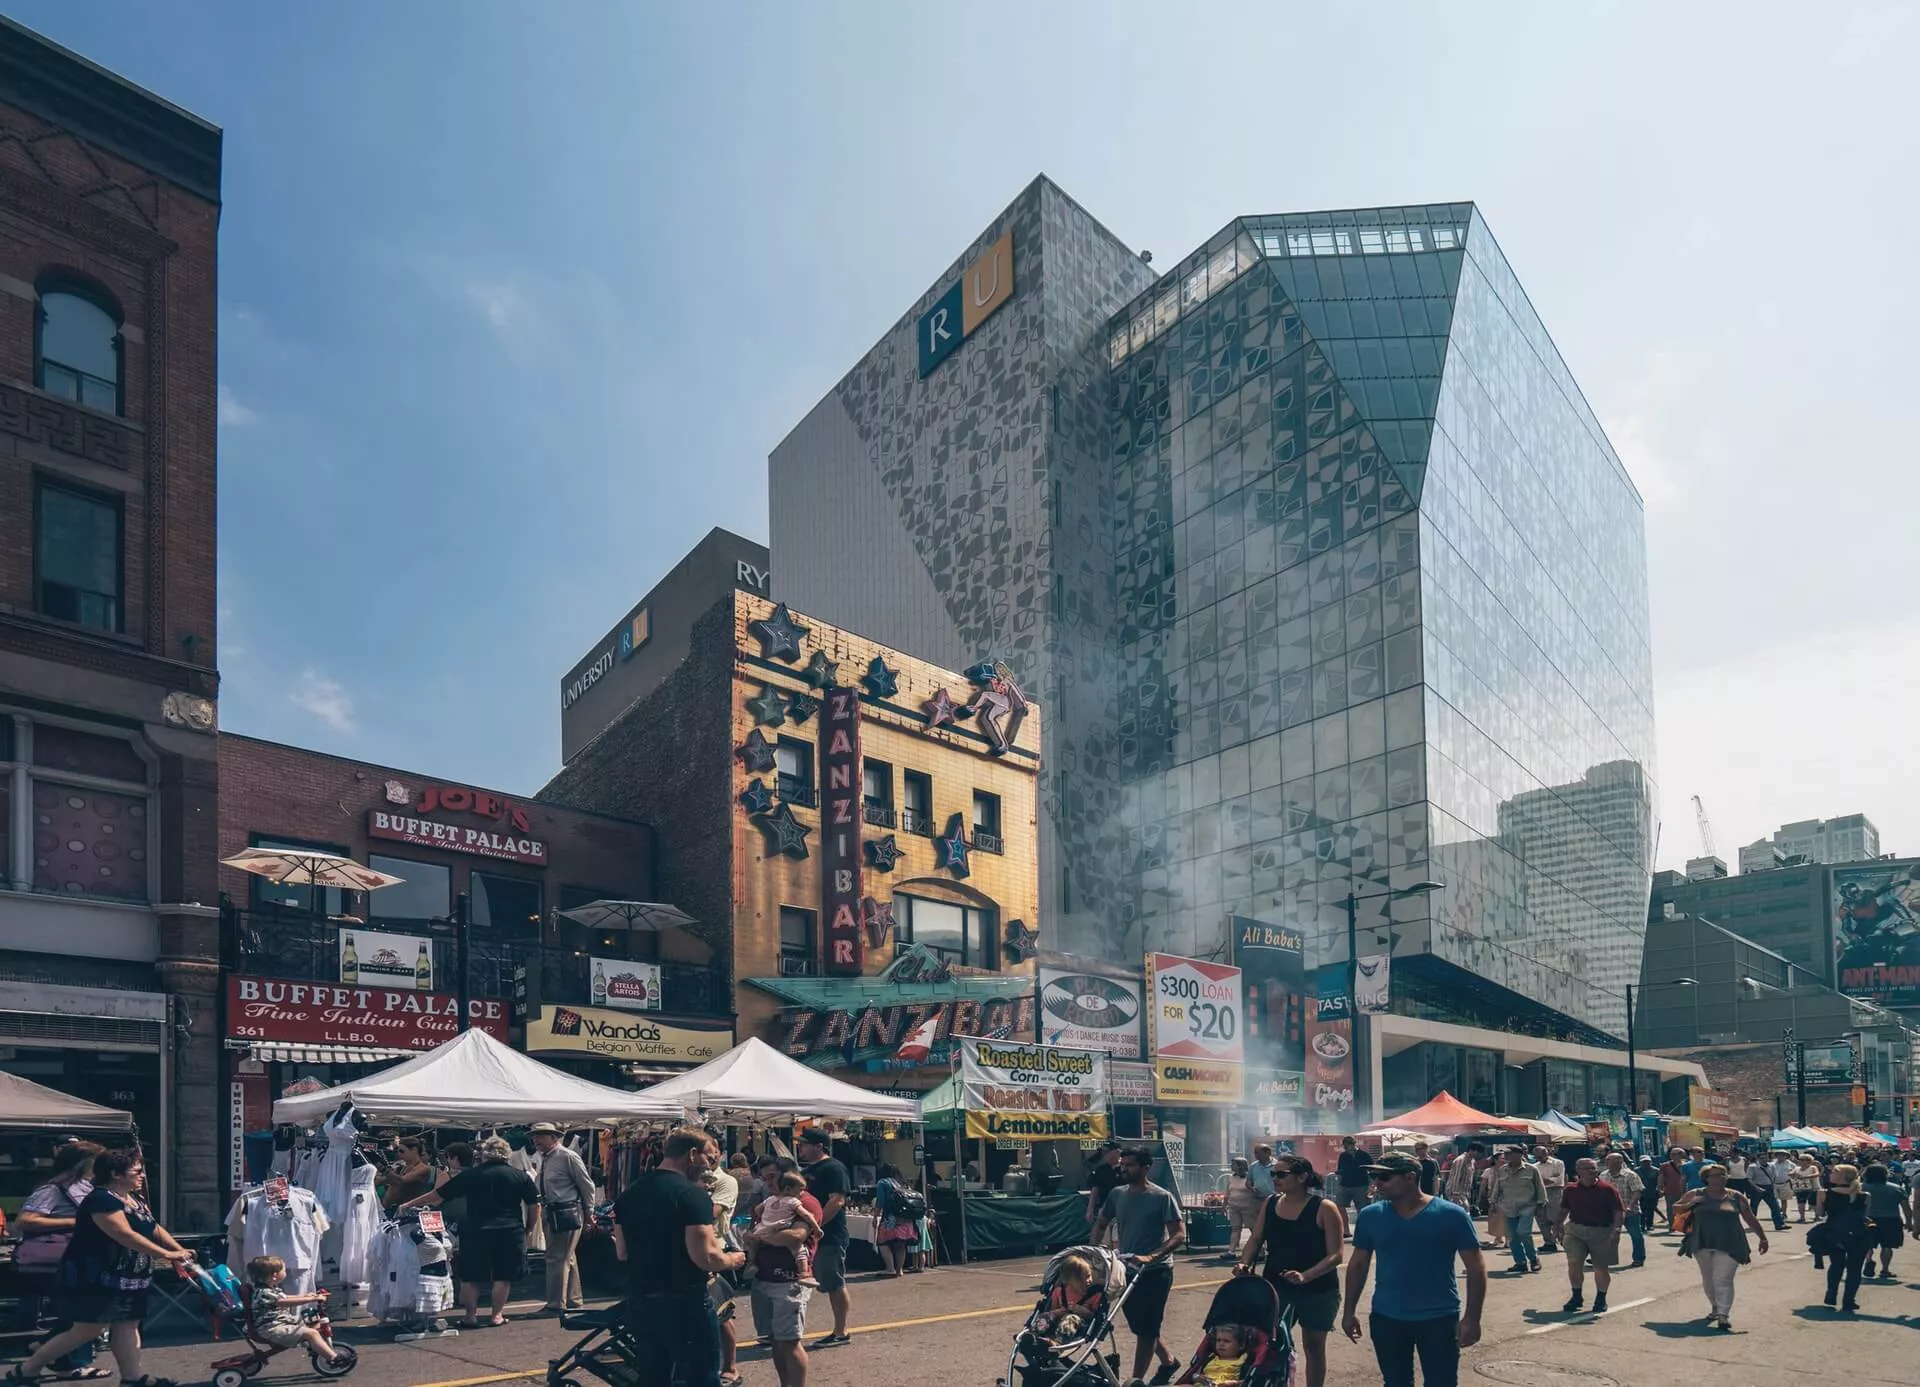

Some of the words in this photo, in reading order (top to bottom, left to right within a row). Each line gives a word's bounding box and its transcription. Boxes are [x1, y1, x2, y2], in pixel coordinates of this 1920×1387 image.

[930, 308, 952, 353] R
[974, 252, 1000, 307] U
[622, 633, 631, 653] R
[562, 647, 616, 710] UNIVERSITY
[416, 784, 530, 833] JOE'S
[375, 811, 459, 842] BUFFET
[465, 828, 543, 857] PALACE
[830, 693, 854, 965] ZANZIBAR
[403, 834, 432, 846] Fine
[436, 839, 476, 853] Indian
[480, 847, 518, 861] Cuisine
[1242, 926, 1260, 944] Ali
[1264, 927, 1302, 950] Baba's
[613, 988, 641, 997] ARTOIS
[614, 982, 640, 991] STELLA
[1160, 974, 1200, 1000] $300
[1201, 983, 1233, 1001] LOAN
[239, 979, 372, 1009] BUFFET
[384, 992, 502, 1020] PALACE
[1086, 996, 1099, 1009] DE
[244, 1002, 309, 1021] Fine
[319, 1008, 408, 1029] Indian
[416, 1015, 495, 1034] Cuise
[583, 1019, 662, 1041] Wanda's
[1163, 1005, 1184, 1020] FOR
[1188, 1000, 1236, 1040] $20
[236, 1025, 265, 1037] 361
[324, 1031, 378, 1044] L.L.B.O.
[1080, 1030, 1101, 1042] DANCE
[1101, 1032, 1120, 1043] MUSIC
[586, 1039, 632, 1054] Belgian
[635, 1042, 677, 1056] Waffles
[686, 1045, 713, 1057] Café
[976, 1042, 1045, 1072] Roasted
[1046, 1049, 1093, 1075] Sweet
[1010, 1070, 1039, 1084] Corn
[1056, 1073, 1080, 1086] Cob
[1270, 1079, 1299, 1093] Baba's
[111, 1090, 136, 1101] 363
[232, 1084, 242, 1129] INDIAN
[983, 1085, 1050, 1111] Roasted
[1051, 1089, 1092, 1112] Yams
[987, 1114, 1091, 1135] Lemonade
[232, 1135, 242, 1189] CUISINE
